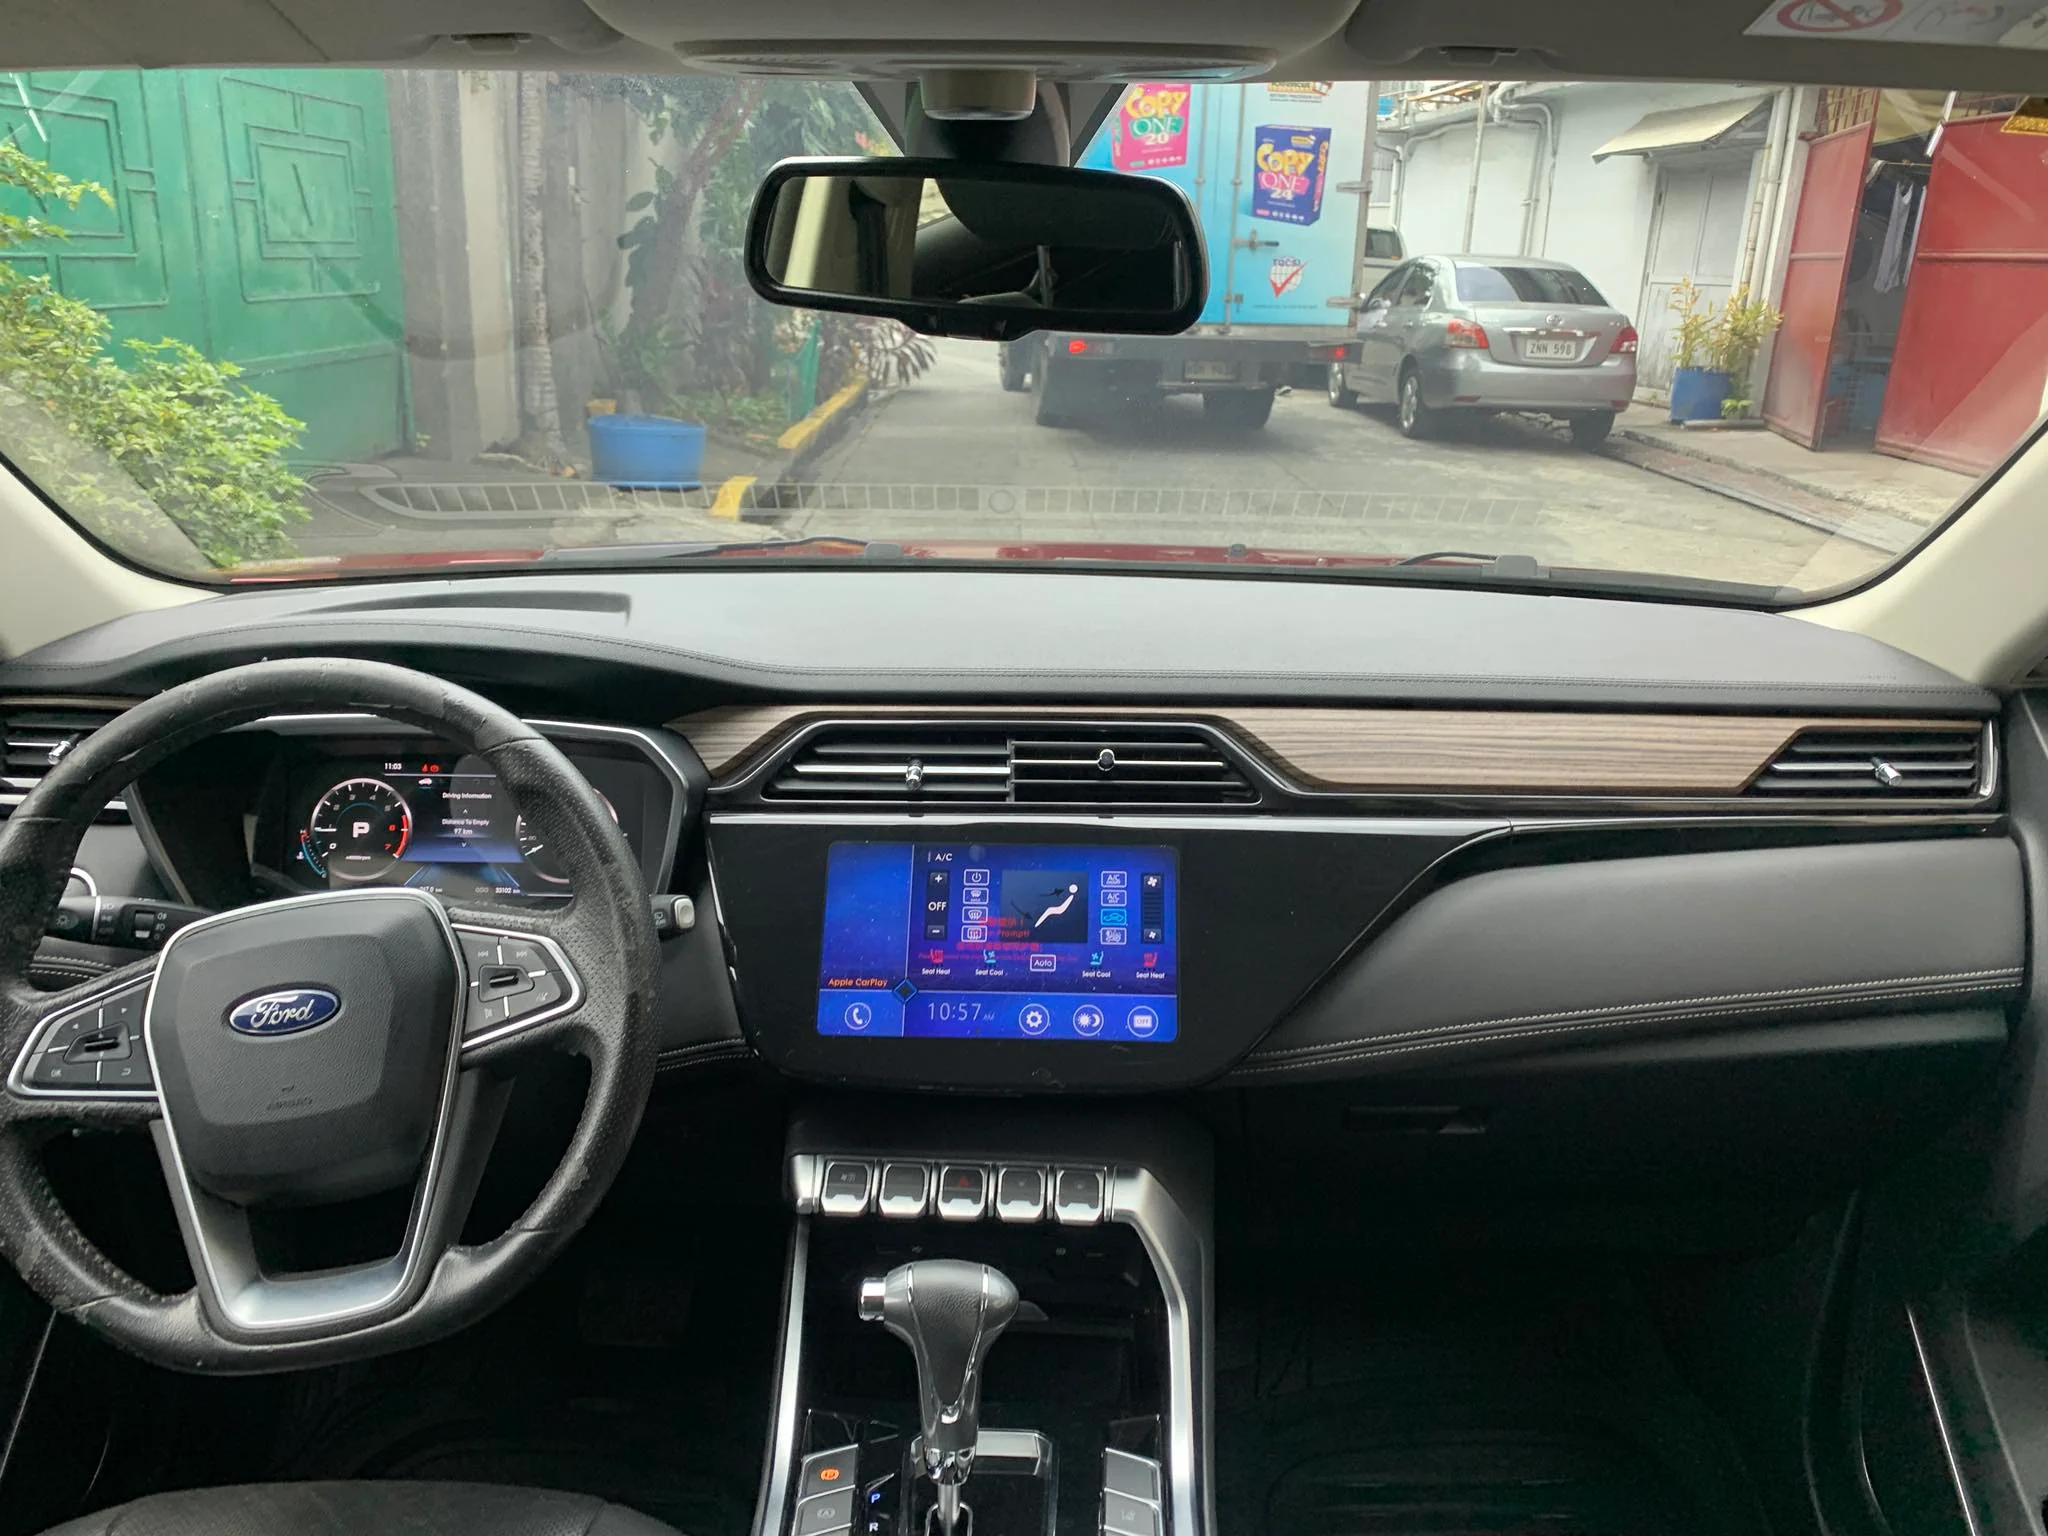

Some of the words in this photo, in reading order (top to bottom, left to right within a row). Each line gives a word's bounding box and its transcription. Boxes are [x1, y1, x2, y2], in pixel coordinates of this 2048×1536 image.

[1133, 116, 1181, 136] ONE
[1144, 132, 1170, 146] 20
[1261, 172, 1304, 193] ONE
[1270, 187, 1296, 201] 24
[442, 792, 461, 800] Driving
[352, 822, 370, 838] P
[934, 853, 953, 862] A/C
[928, 902, 948, 912] OFF
[1033, 959, 1053, 968] Auto
[921, 967, 934, 976] Seat
[935, 967, 951, 976] Heat
[975, 968, 987, 976] Seat
[988, 968, 1004, 976] Cool
[1082, 970, 1096, 978] Seat
[1096, 970, 1111, 979] Cool
[1136, 971, 1149, 979] Seat
[828, 978, 853, 988] Apple
[855, 978, 888, 989] CarPlay
[250, 995, 316, 1028] Ford
[928, 1002, 982, 1022] 10:57
[50, 1069, 62, 1077] OK
[871, 1493, 881, 1504] P
[869, 1522, 879, 1532] R
